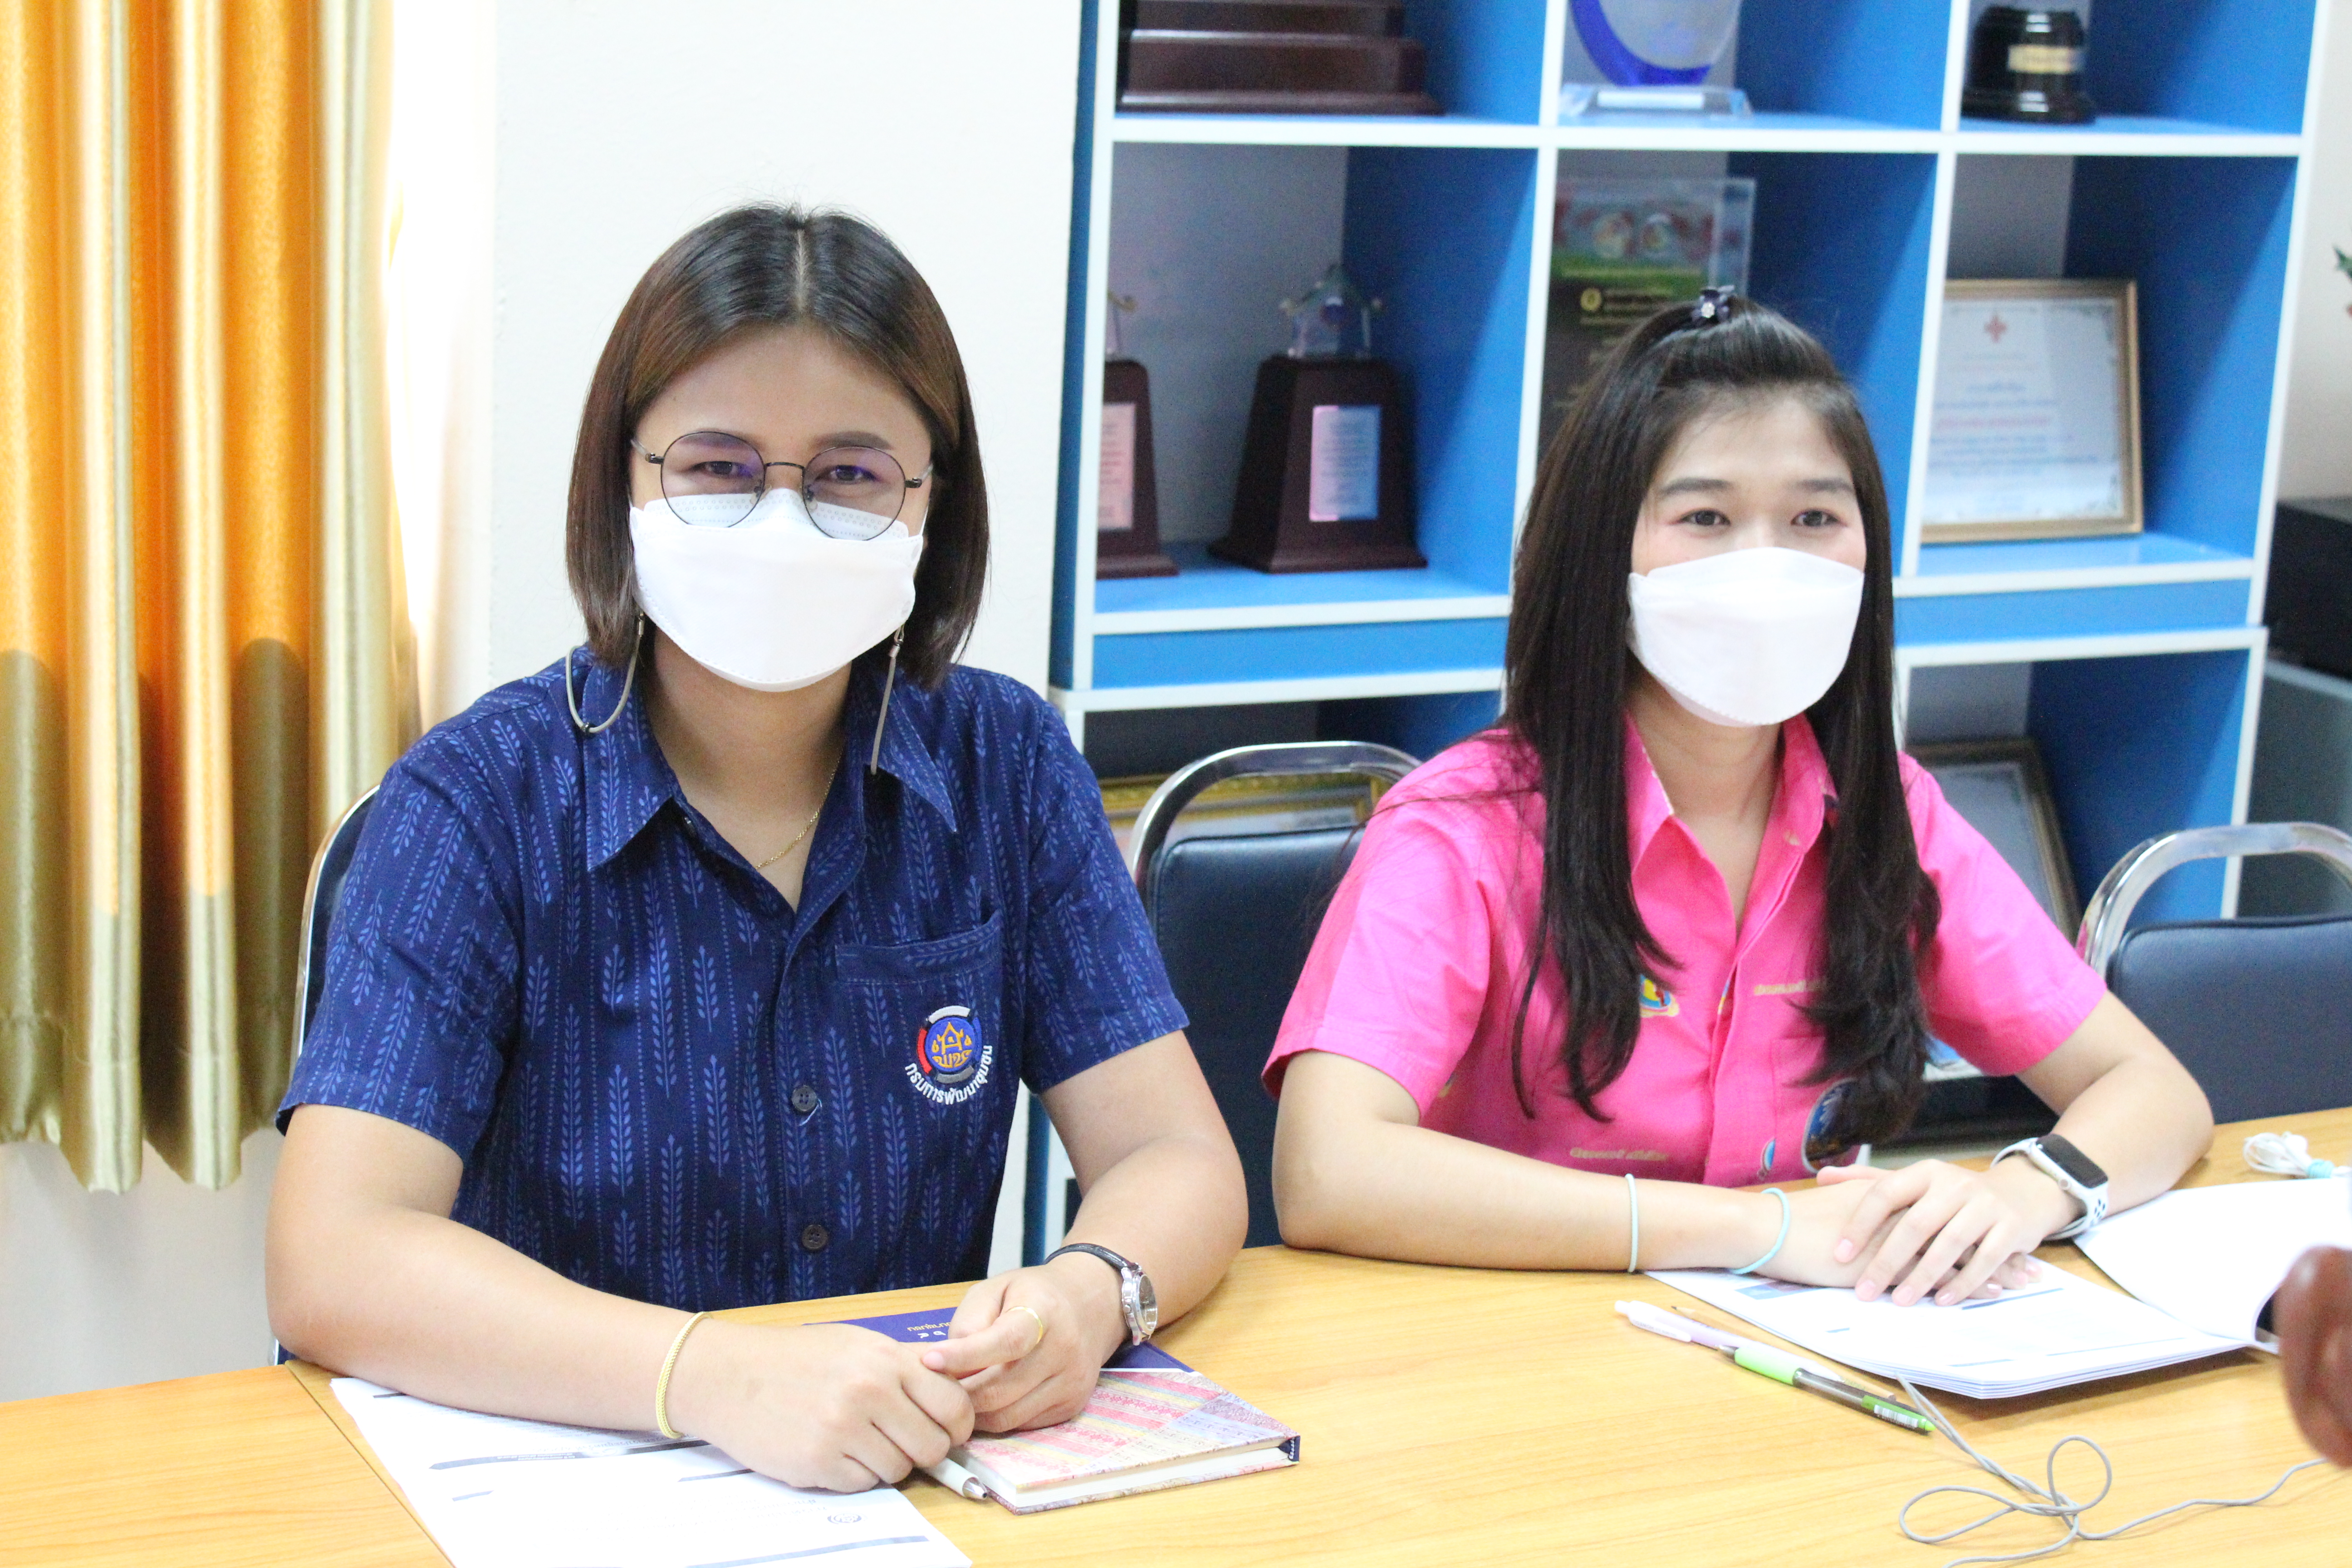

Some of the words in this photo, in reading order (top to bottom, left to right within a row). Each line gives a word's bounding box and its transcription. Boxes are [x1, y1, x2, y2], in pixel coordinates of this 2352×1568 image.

[905, 1045, 993, 1105] กรมการพัฒนาชุมชน
